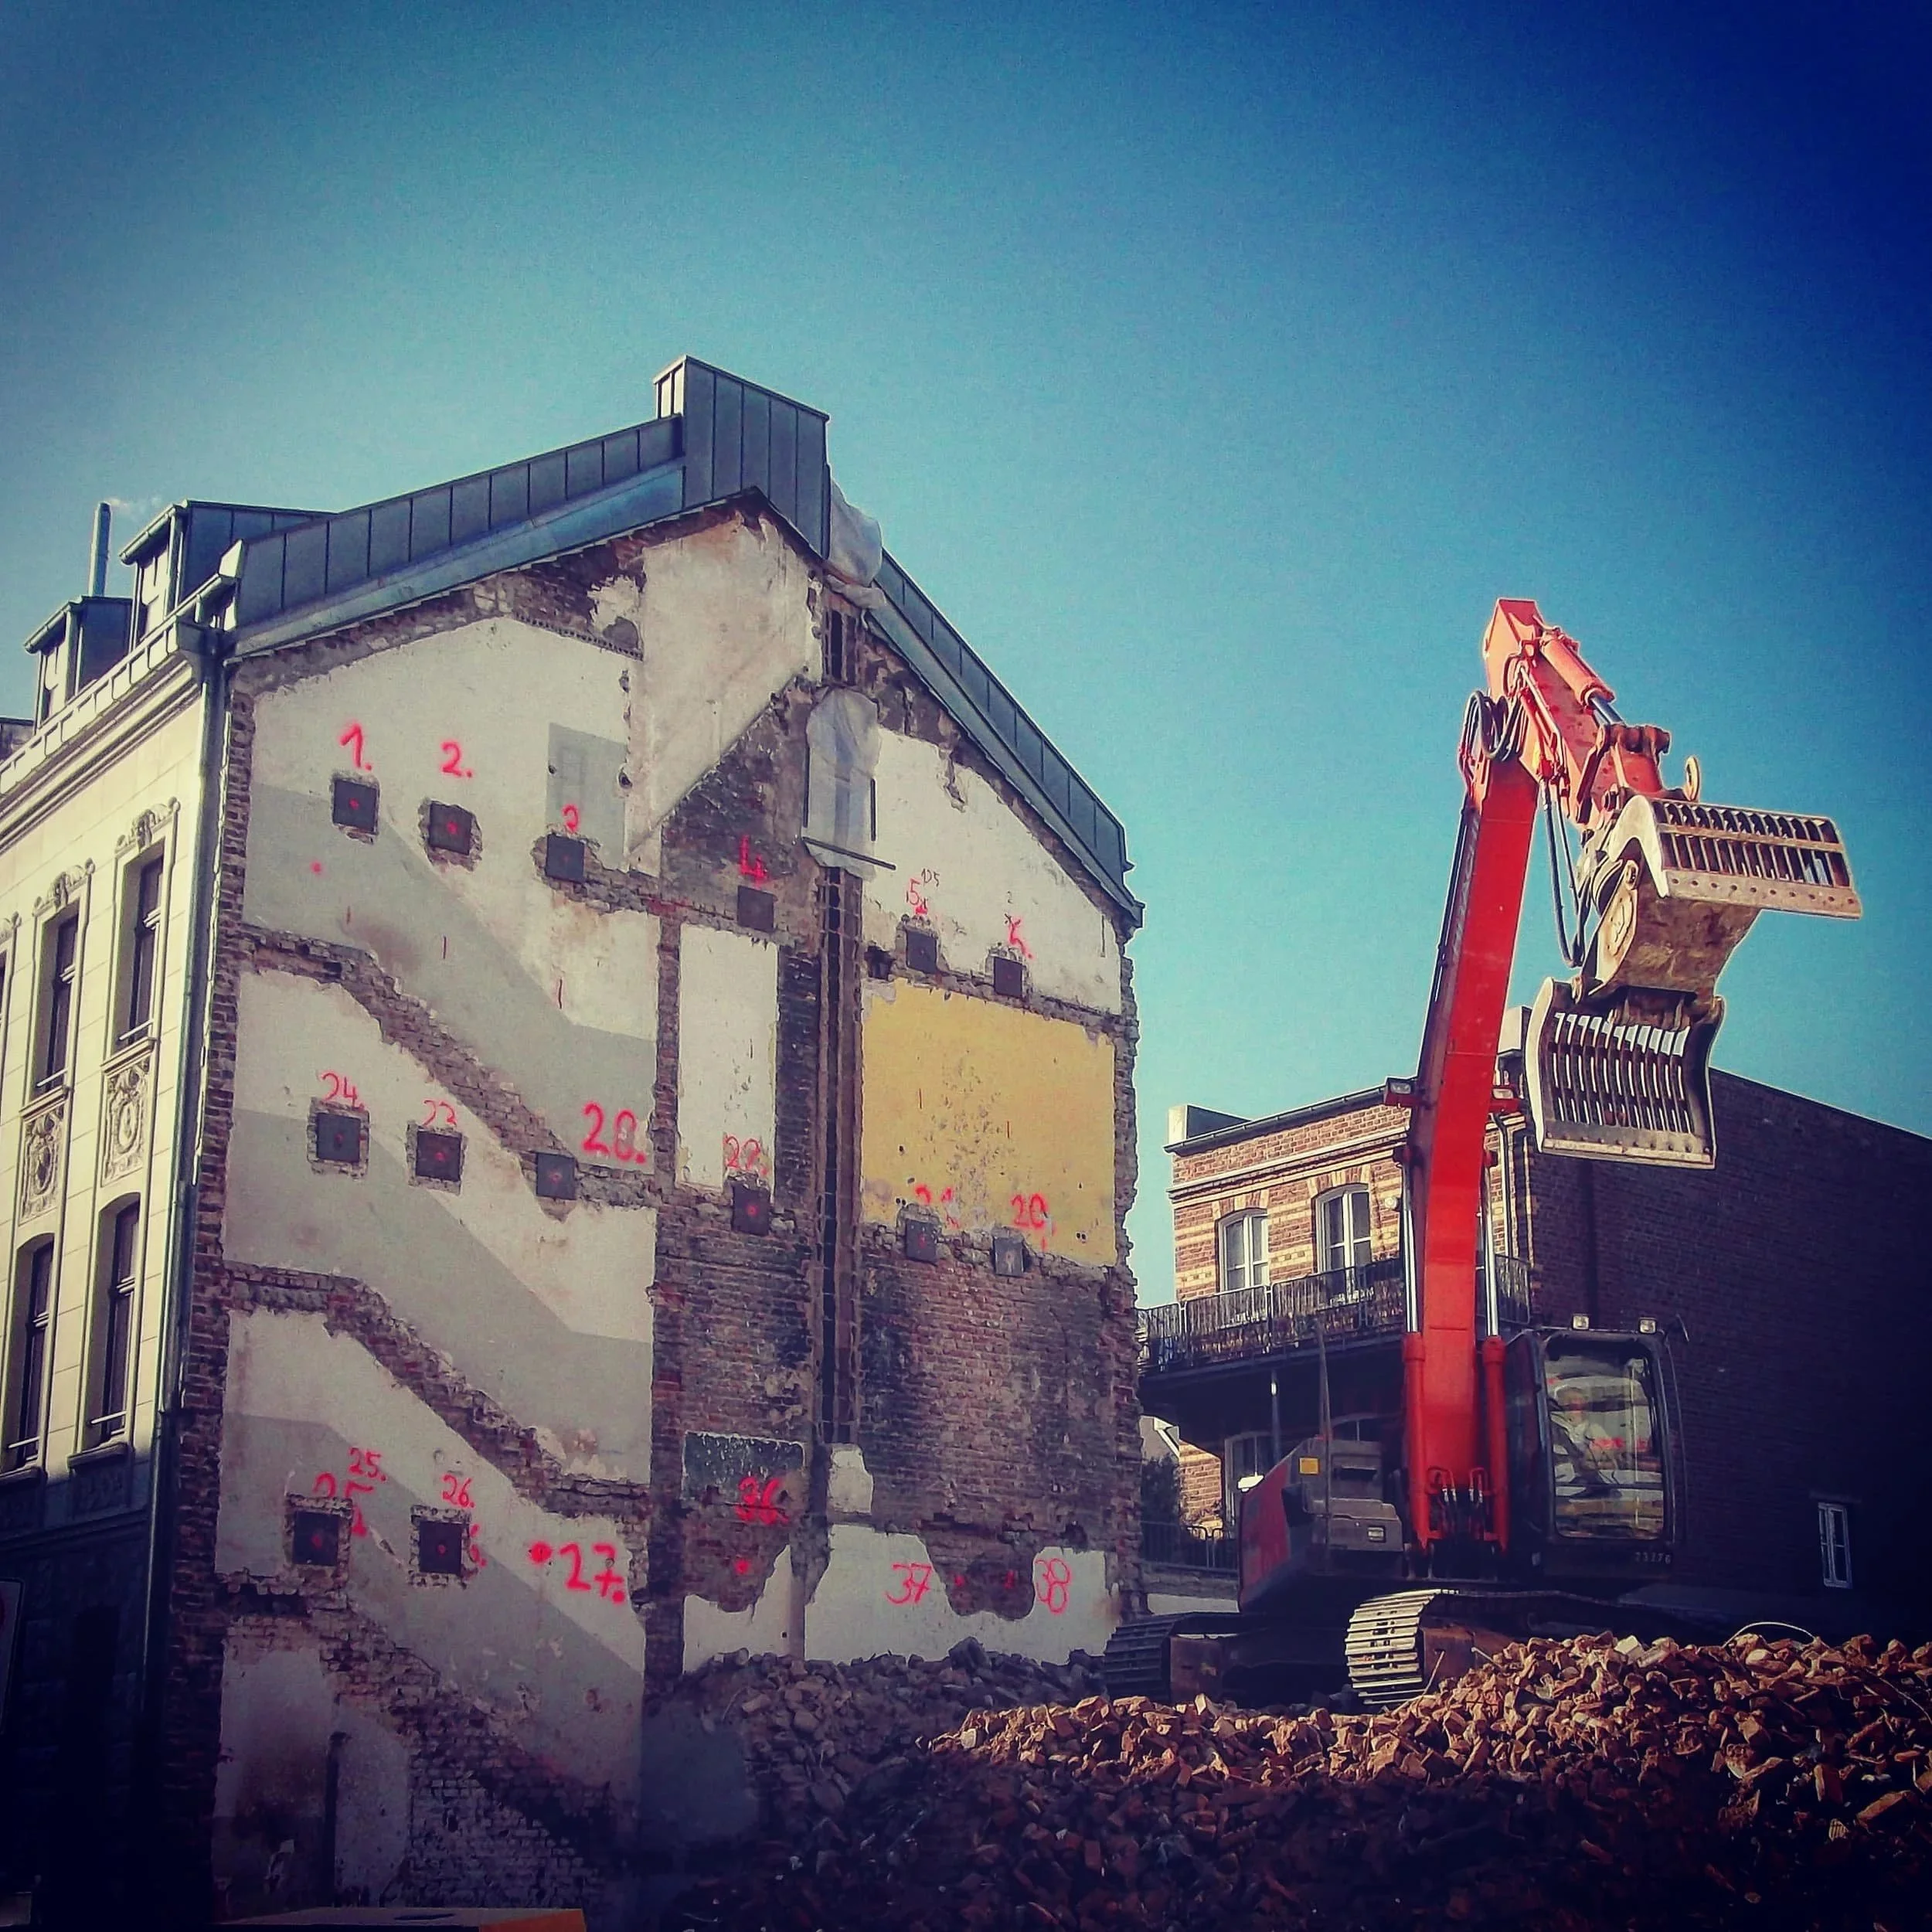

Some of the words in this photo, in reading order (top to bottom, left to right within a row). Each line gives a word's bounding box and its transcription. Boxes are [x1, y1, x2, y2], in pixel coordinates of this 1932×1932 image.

[340, 723, 372, 770] 1.
[440, 741, 473, 778] 2.
[441, 1474, 475, 1509] 26.
[886, 1562, 933, 1605] 37
